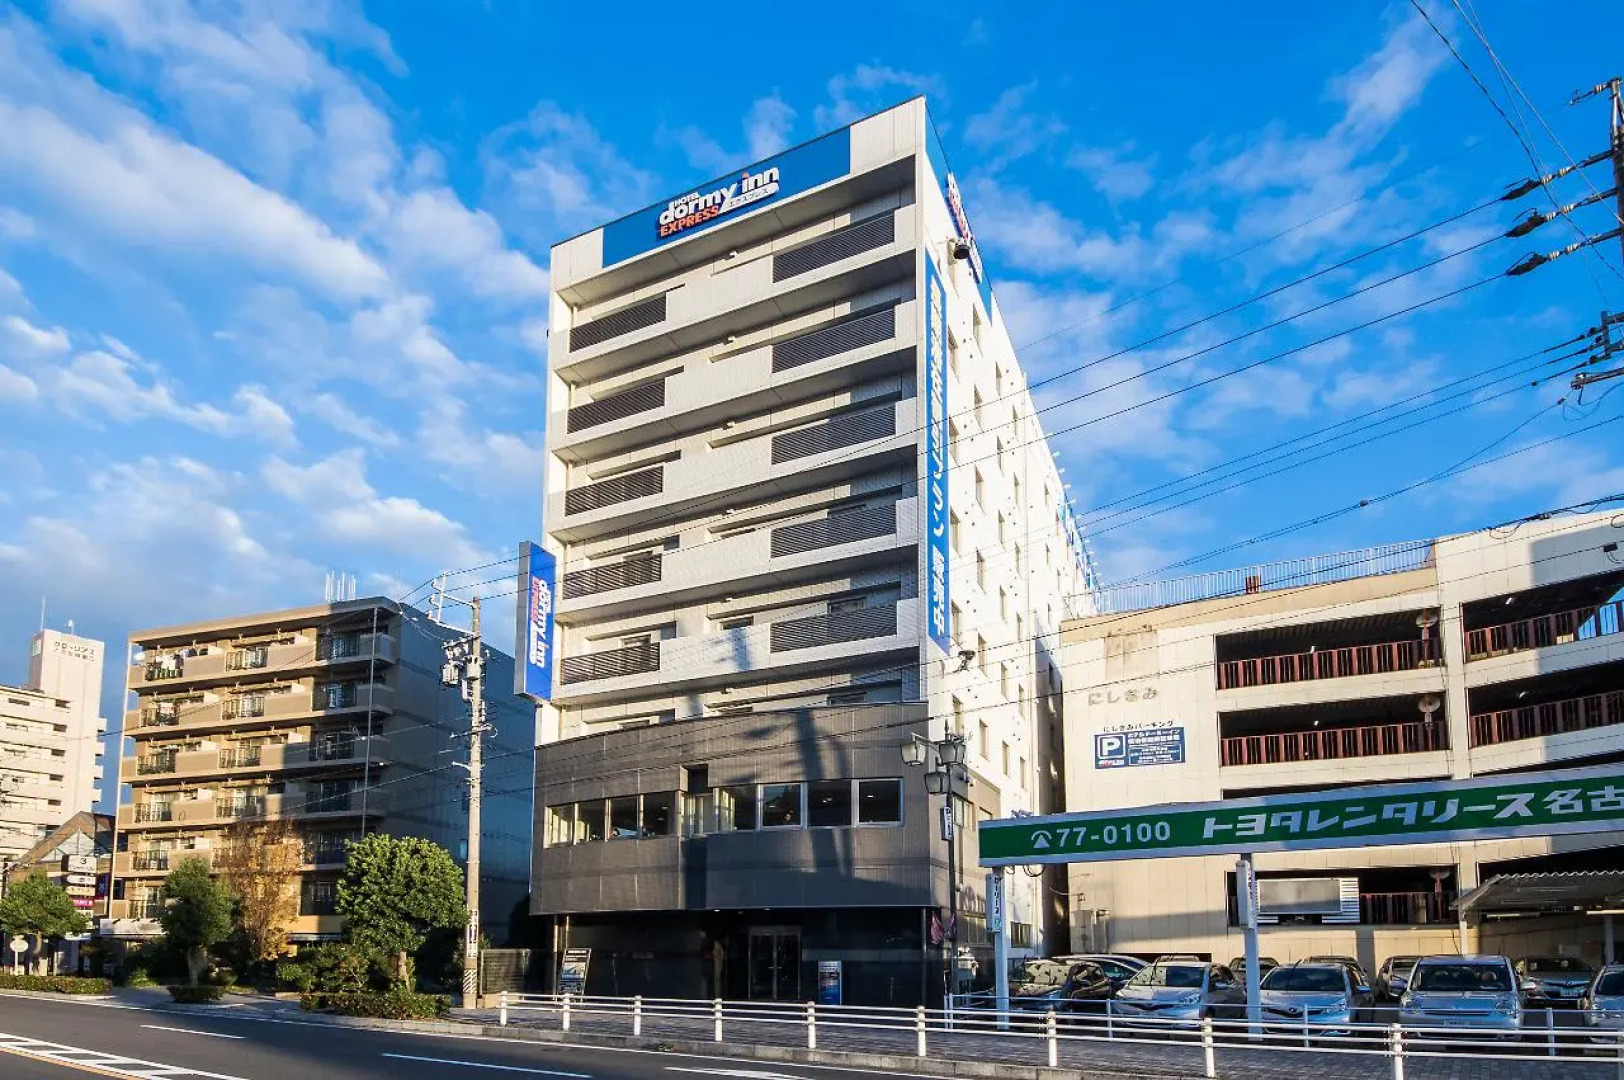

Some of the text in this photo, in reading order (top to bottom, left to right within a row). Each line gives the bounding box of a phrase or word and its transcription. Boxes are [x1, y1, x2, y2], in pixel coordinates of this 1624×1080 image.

[660, 167, 780, 225] dormy inn
[660, 205, 720, 237] EXPRESS
[1057, 821, 1171, 848] 77-0100
